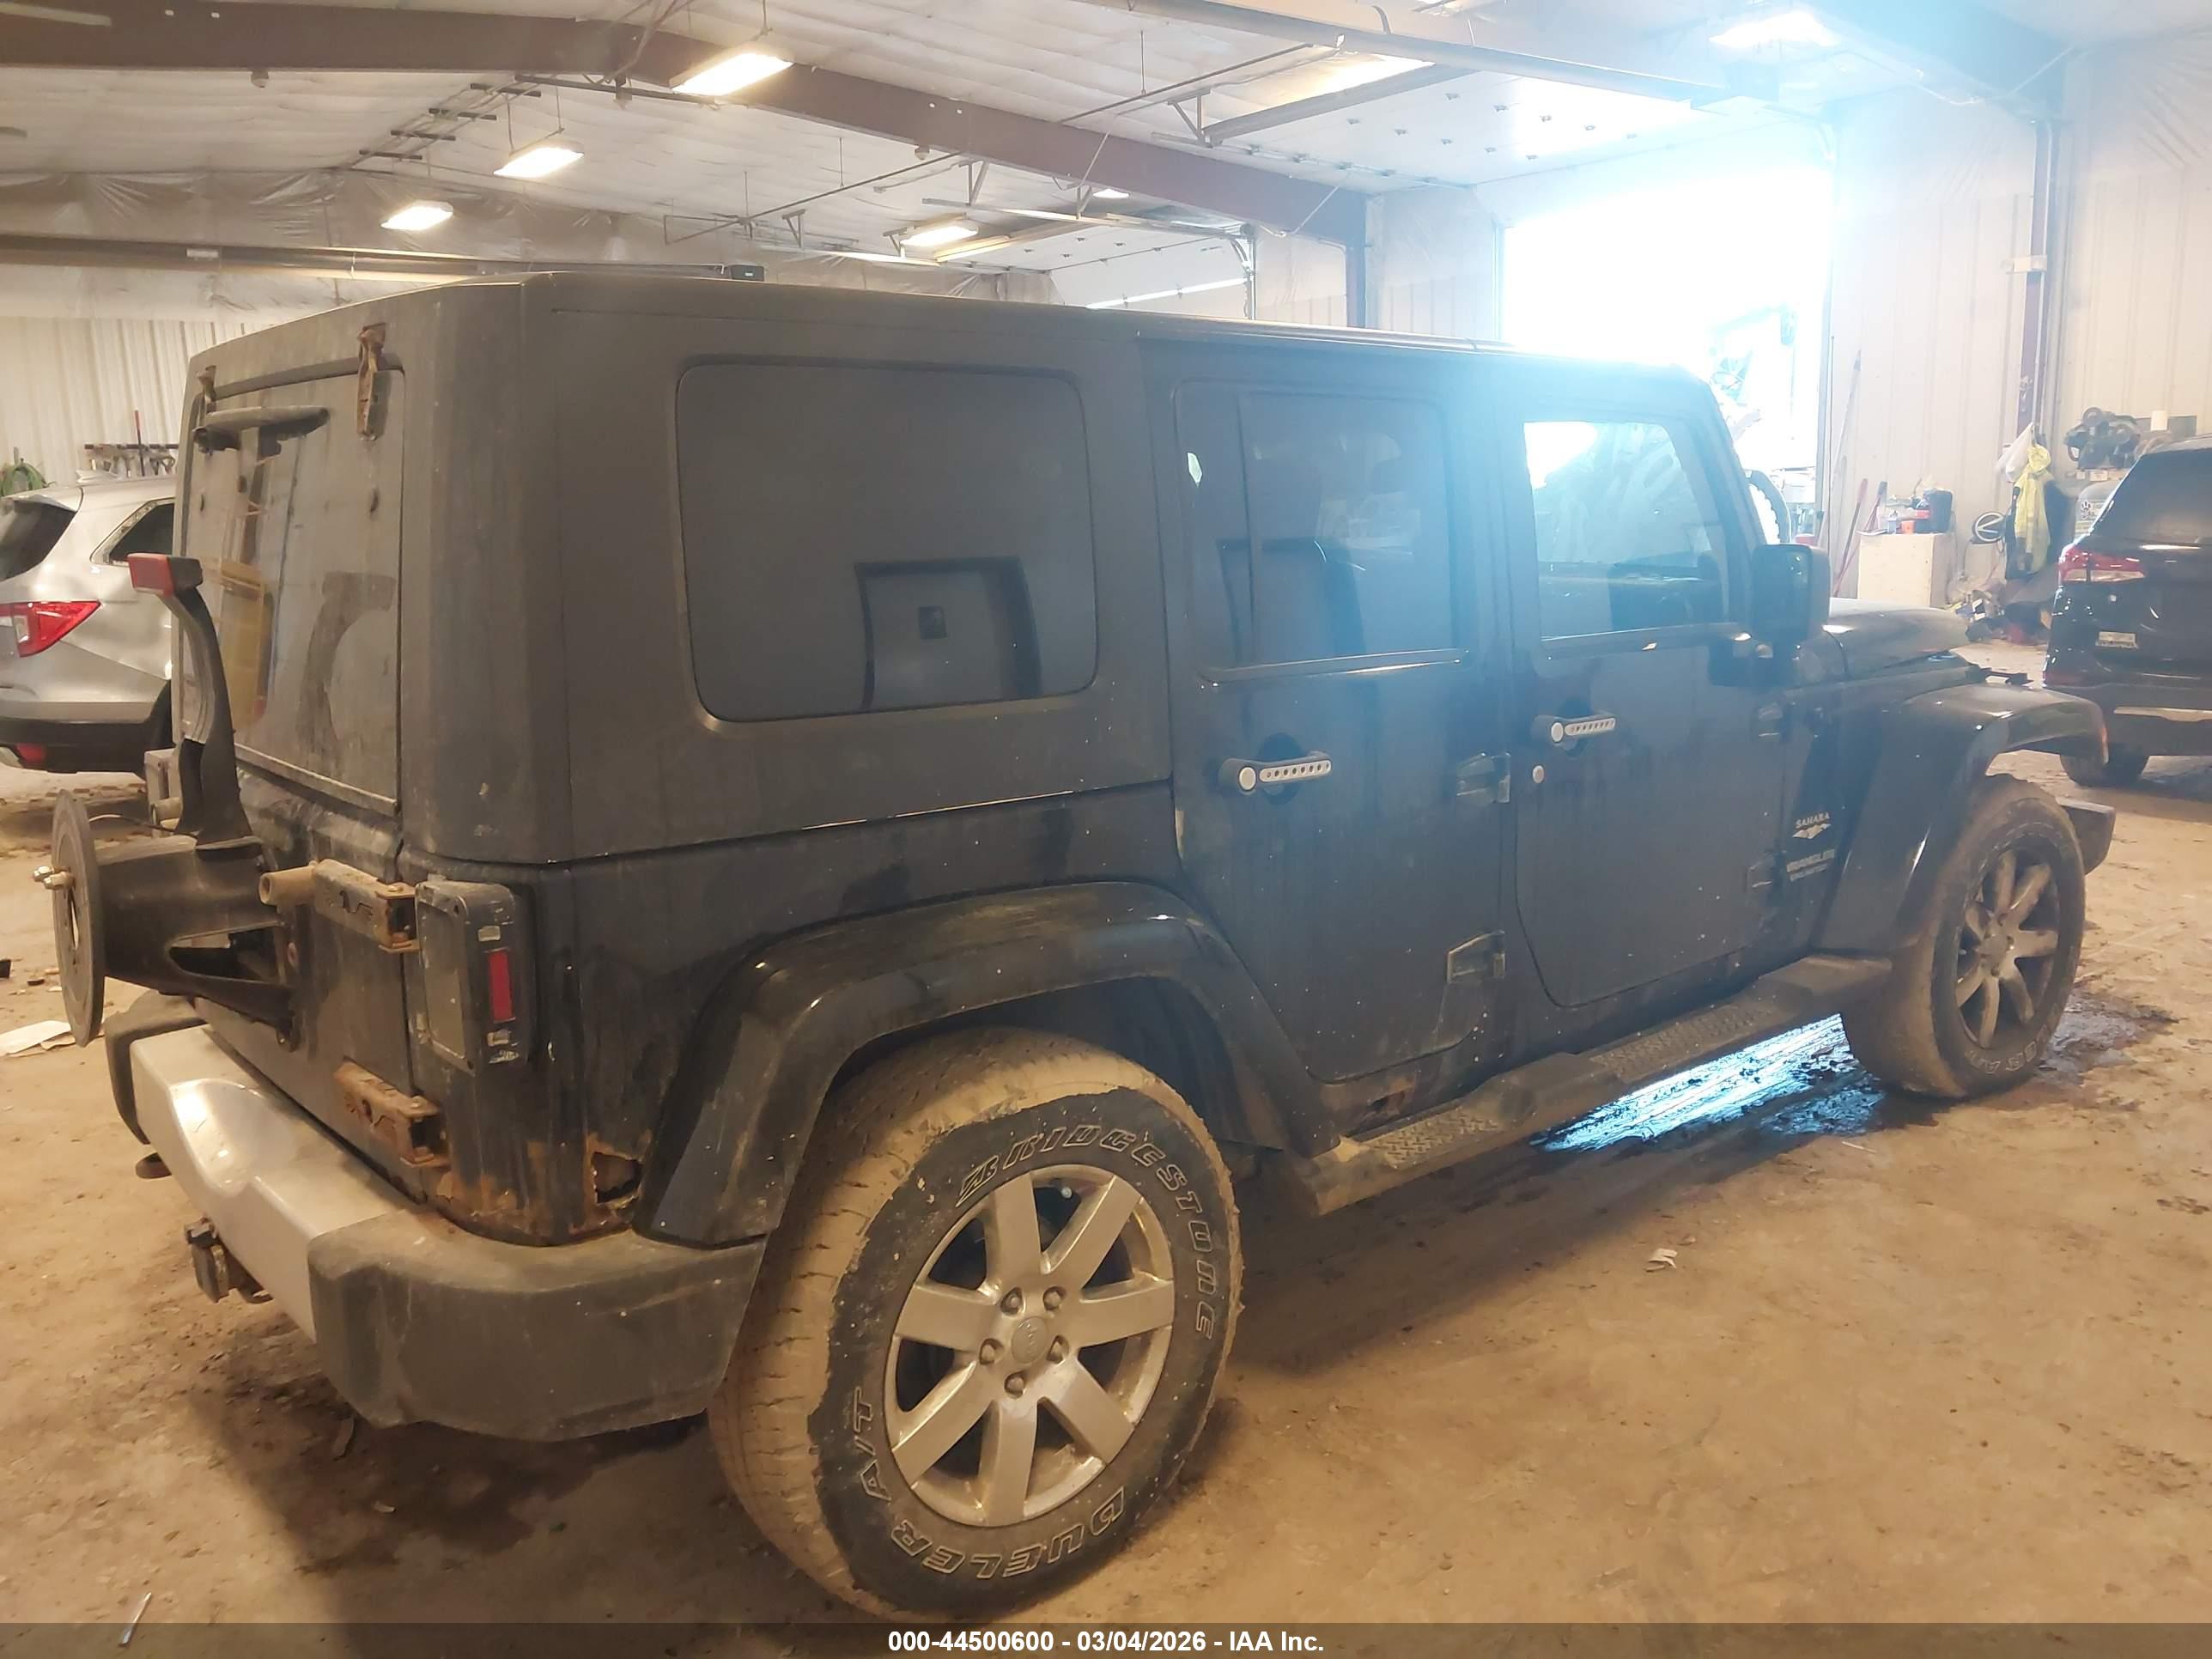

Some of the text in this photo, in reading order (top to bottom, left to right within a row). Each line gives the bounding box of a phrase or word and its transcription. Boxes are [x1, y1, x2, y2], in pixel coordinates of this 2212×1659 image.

[1795, 811, 1831, 829] SAHARA
[955, 1124, 1217, 1340] BRIDGESTONE
[852, 1386, 1125, 1580] DUELER A/T
